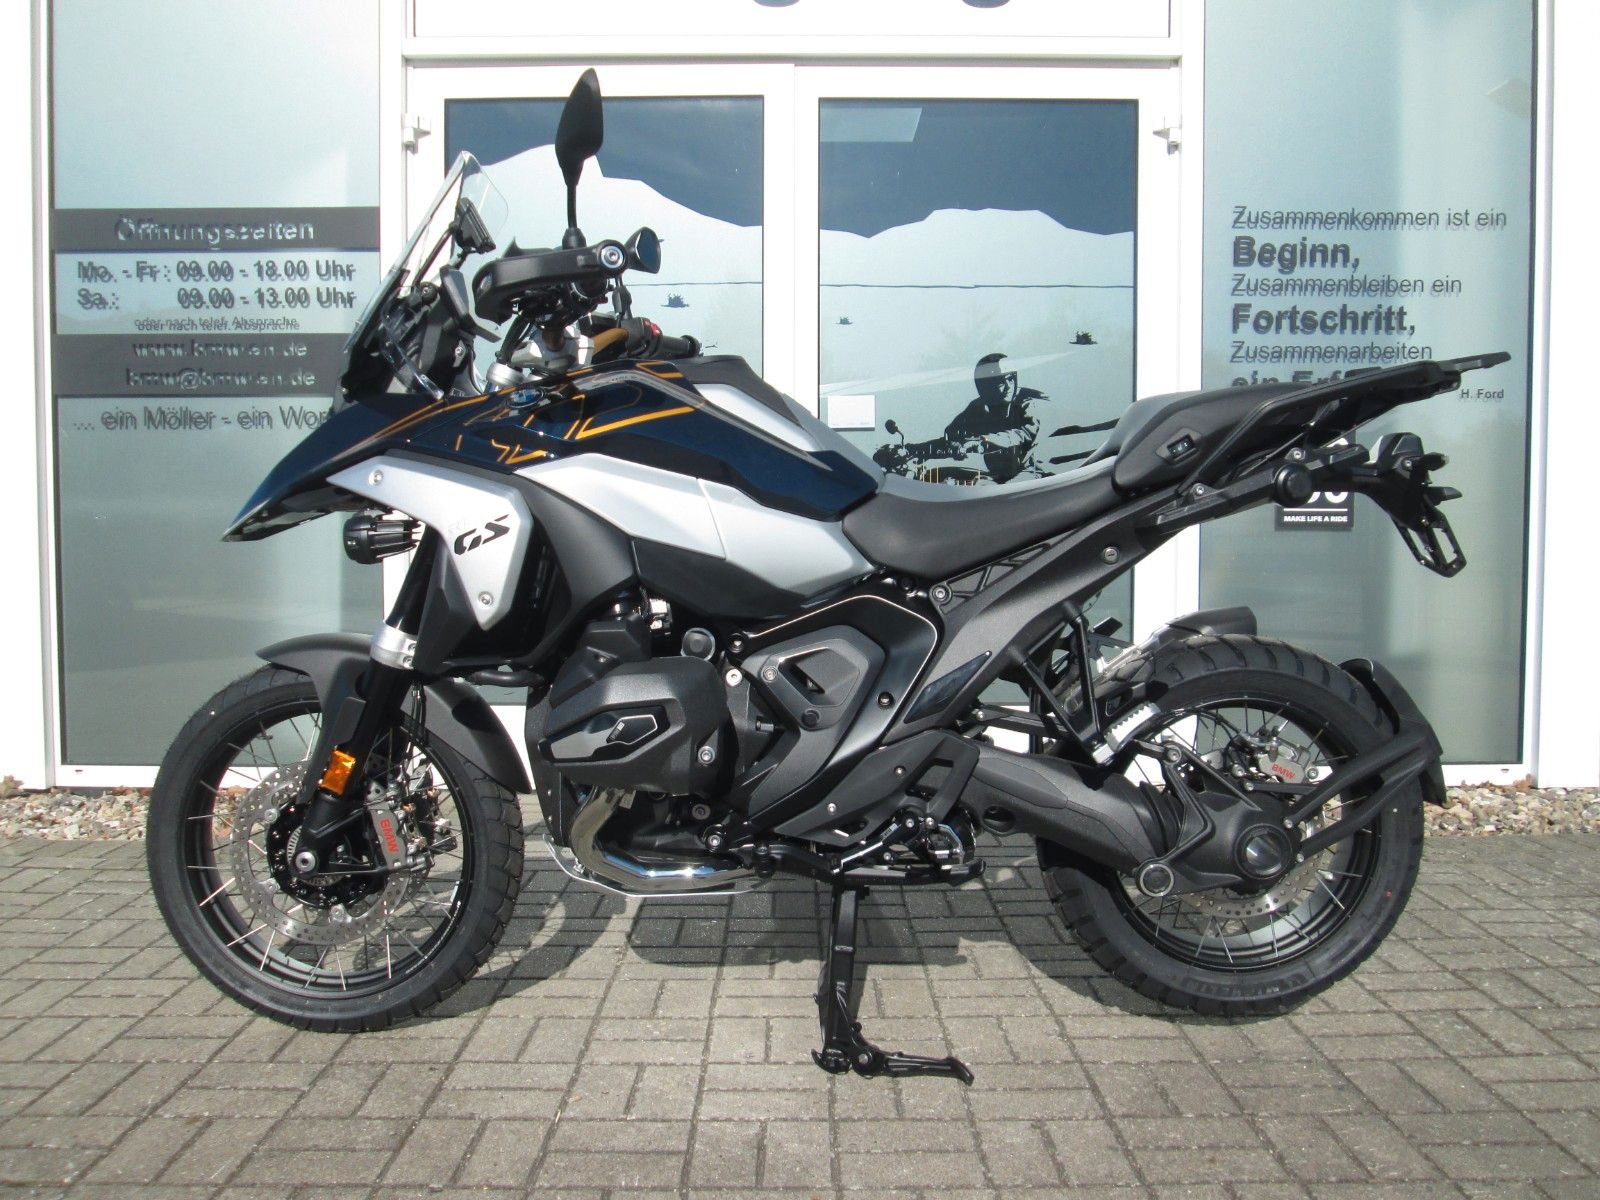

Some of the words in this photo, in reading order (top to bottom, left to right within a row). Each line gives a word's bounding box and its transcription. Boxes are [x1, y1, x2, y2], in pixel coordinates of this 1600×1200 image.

[115, 214, 314, 246] Öffnungszeiten
[1232, 206, 1439, 230] Zusammenkommen
[1447, 208, 1471, 228] ist
[1476, 208, 1507, 228] ein
[1233, 236, 1360, 274] Beginn,
[78, 261, 117, 282] Mo.
[177, 260, 234, 282] 09.00
[254, 260, 309, 282] 18.00
[316, 260, 356, 282] Uhr
[1231, 273, 1424, 297] Zusammenbleiben
[1431, 275, 1462, 295] ein
[178, 287, 235, 309] 09.00
[254, 287, 310, 309] 13.00
[316, 287, 357, 309] Uhr
[135, 317, 165, 331] oder
[166, 317, 198, 331] nach
[232, 316, 300, 332] Absprache
[1232, 303, 1416, 337] Fortschritt,
[1230, 341, 1432, 363] Zusammenarbeiten
[1461, 389, 1473, 400] H.
[1477, 389, 1505, 400] Ford
[101, 406, 137, 430] ein
[144, 406, 216, 430] Möller
[237, 406, 273, 430] ein
[454, 514, 510, 556] GS
[1271, 763, 1296, 779] BMW
[379, 818, 400, 854] BMW
